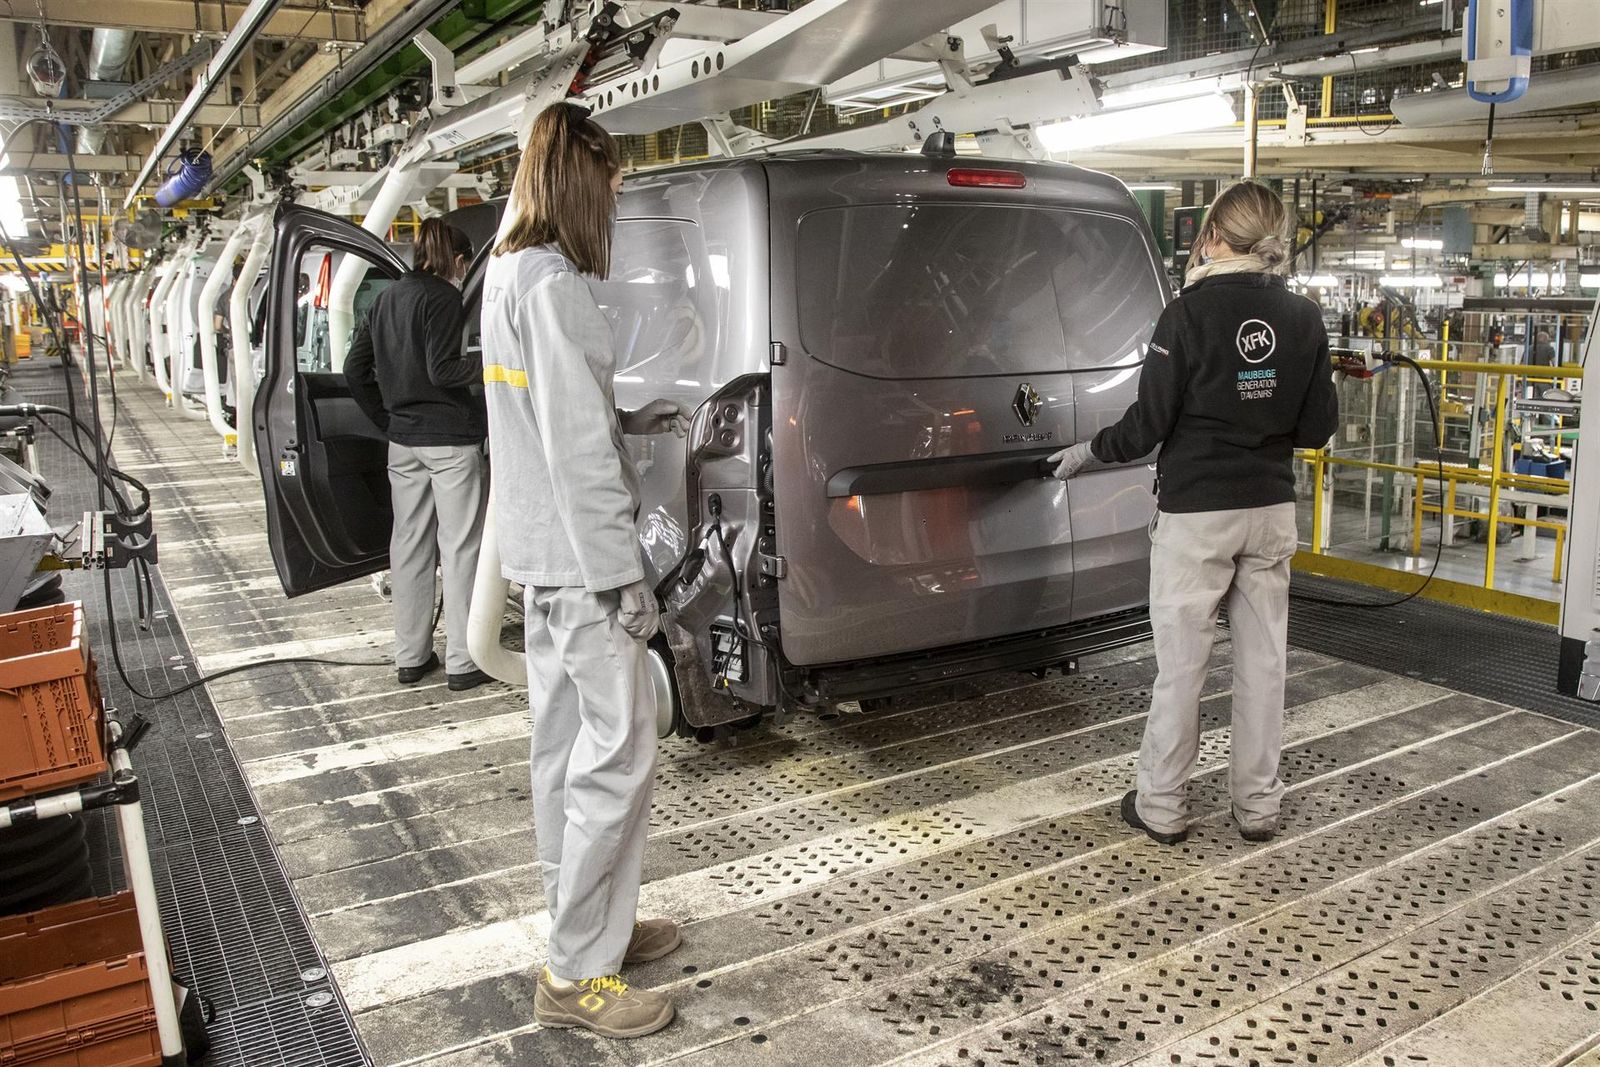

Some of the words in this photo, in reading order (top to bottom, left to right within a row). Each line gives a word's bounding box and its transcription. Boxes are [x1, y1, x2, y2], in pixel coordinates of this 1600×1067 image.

[1241, 330, 1271, 353] XFK
[1238, 369, 1276, 380] MAUBEUGE
[1237, 379, 1277, 390] GENERATION
[1240, 389, 1273, 400] D'AVENIRS
